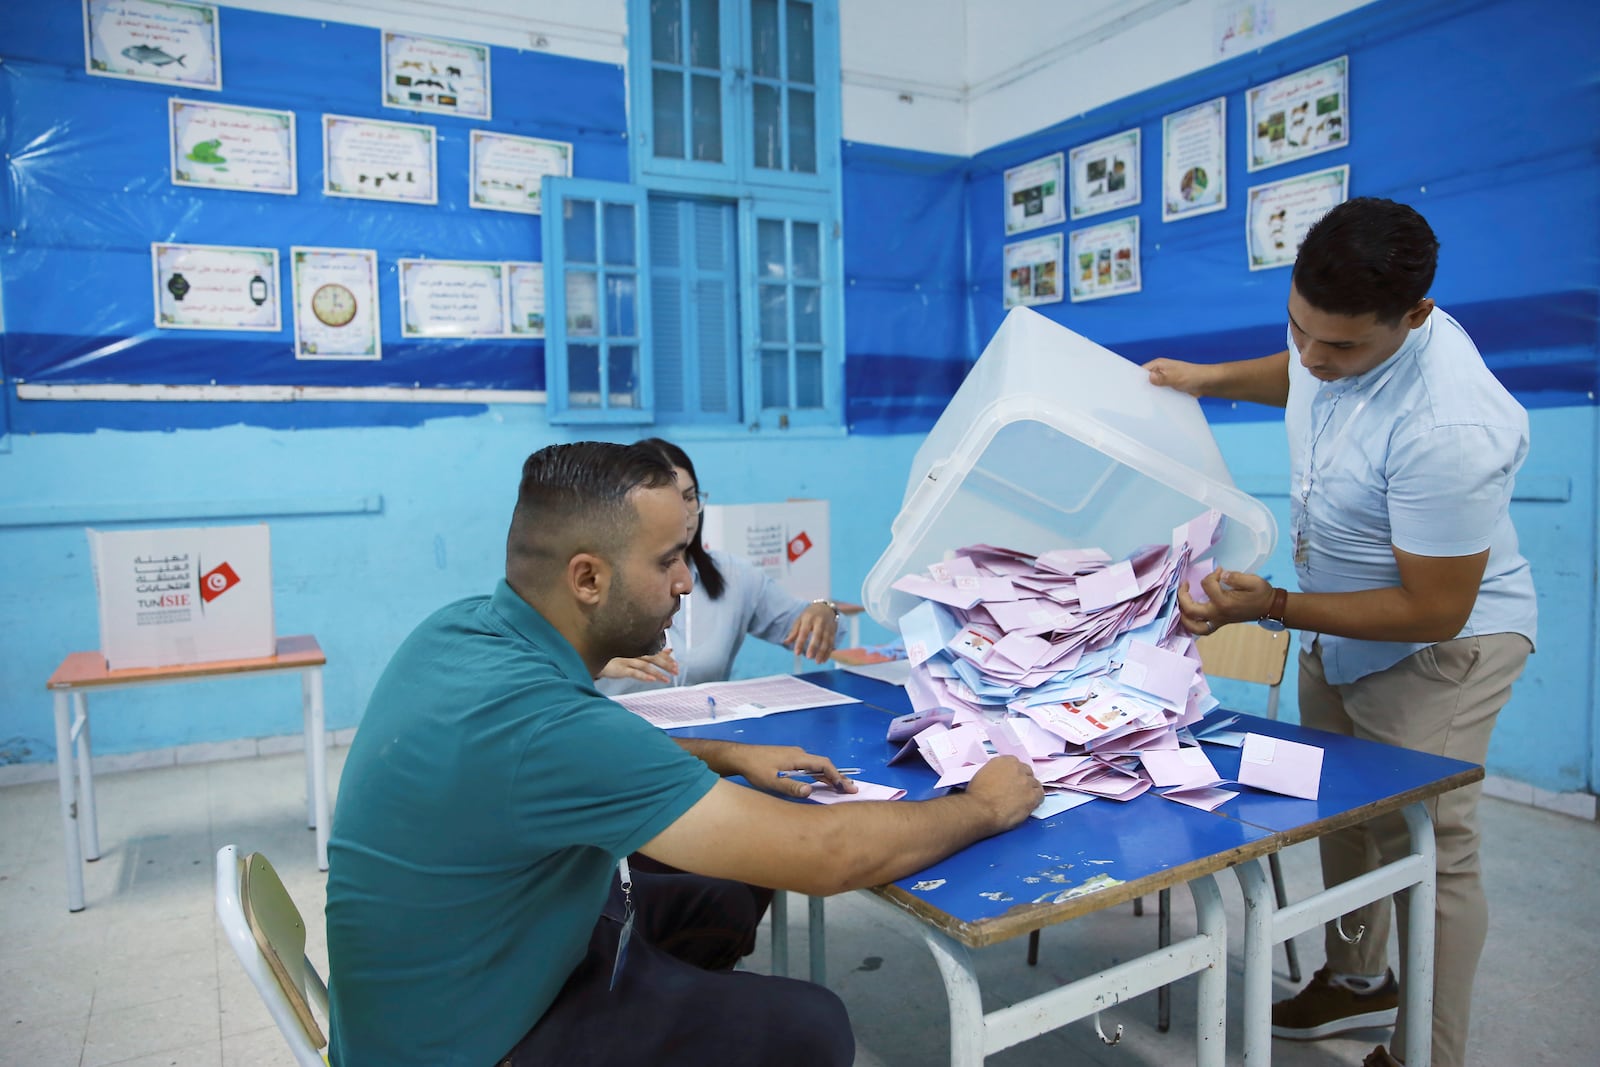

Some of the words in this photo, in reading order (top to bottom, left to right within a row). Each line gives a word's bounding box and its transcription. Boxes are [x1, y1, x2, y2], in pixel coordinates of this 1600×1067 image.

[134, 554, 188, 564] الهيئة
[134, 563, 190, 574] العليا
[136, 573, 190, 583] المستقلة
[138, 593, 191, 608] TUNISIE
